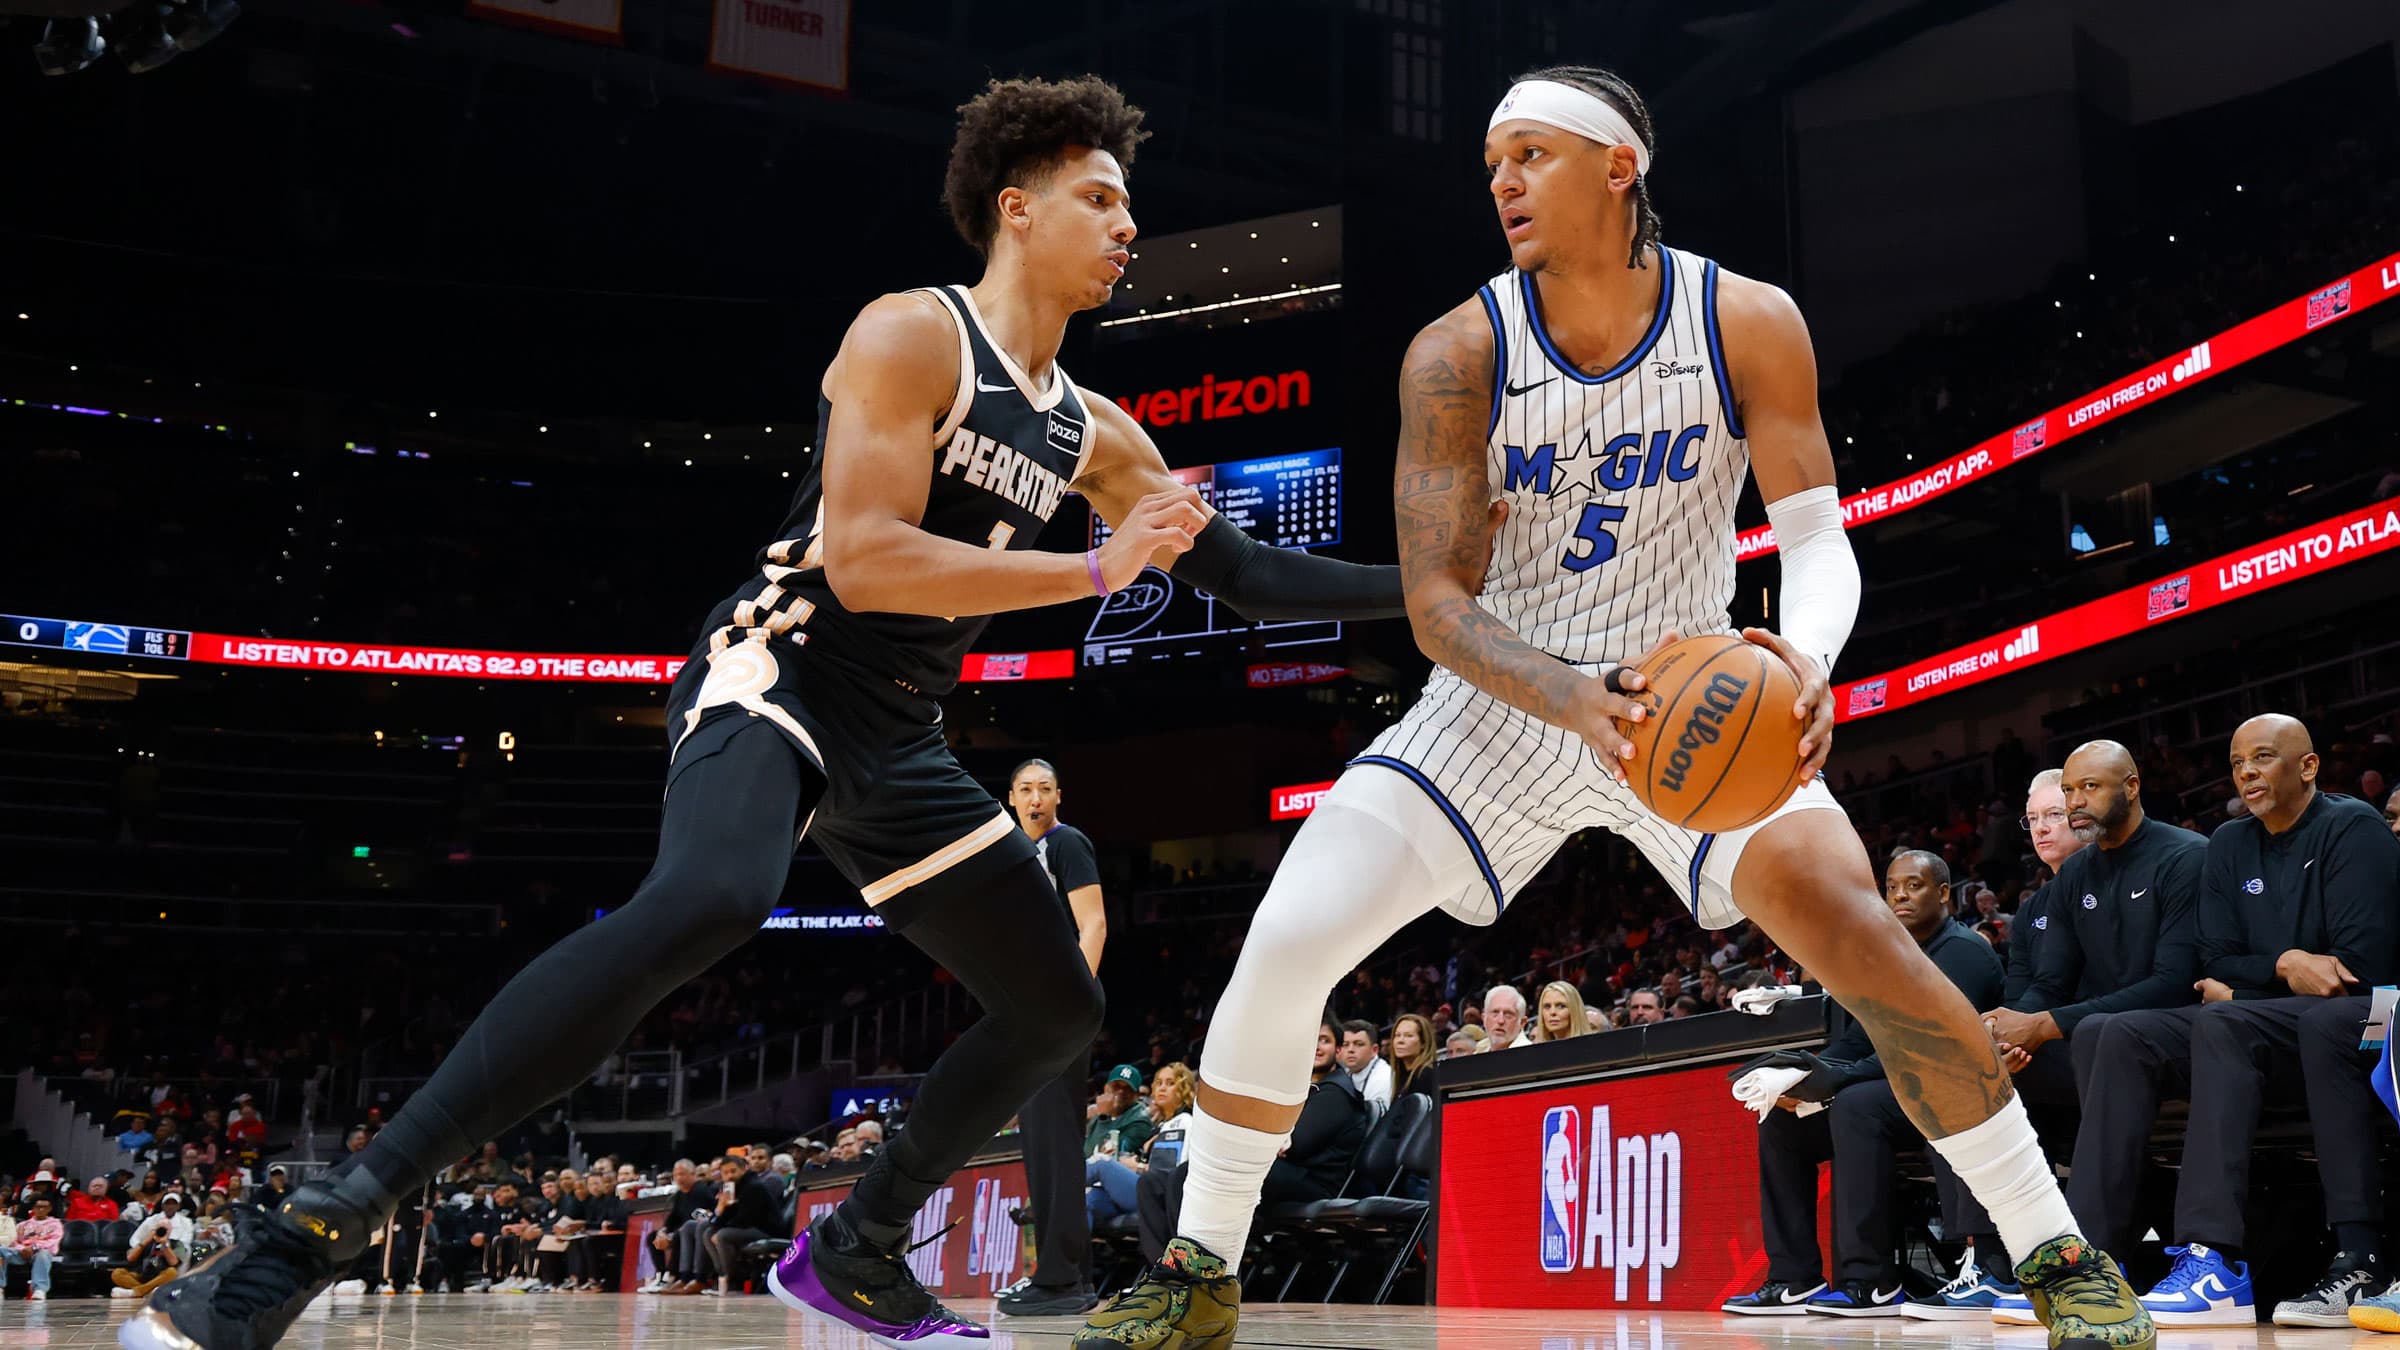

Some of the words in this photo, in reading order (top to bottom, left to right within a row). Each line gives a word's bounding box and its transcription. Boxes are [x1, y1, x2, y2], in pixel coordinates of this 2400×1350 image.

[743, 0, 824, 38] TURNER
[1115, 369, 1311, 427] verizon
[2068, 396, 2111, 428] LISTEN
[2112, 382, 2145, 408] FREE
[2146, 372, 2167, 392] ON
[1050, 420, 1080, 443] paze
[1853, 496, 1888, 519] THE
[1890, 464, 1954, 507] AUDACY
[1956, 450, 1993, 480] APP.
[1560, 502, 1629, 573] 5
[2218, 544, 2297, 590] LISTEN
[2297, 534, 2333, 562] TO
[2337, 510, 2400, 552] ATLA
[20, 623, 39, 641] 0
[144, 643, 164, 655] TOL
[167, 646, 176, 656] 7
[145, 632, 164, 642] FLS
[223, 641, 311, 664] LISTEN
[313, 647, 348, 666] TO
[351, 649, 483, 673] ATLANTA'S
[486, 656, 536, 675] 92.9
[538, 659, 584, 677] THE
[587, 659, 662, 681] GAME,
[1907, 667, 1948, 693] LISTEN
[1949, 656, 1978, 679] FREE
[1979, 649, 1999, 667] ON
[1659, 671, 1750, 792] Wilson
[800, 917, 828, 929] THE
[1582, 1104, 1681, 1302] App
